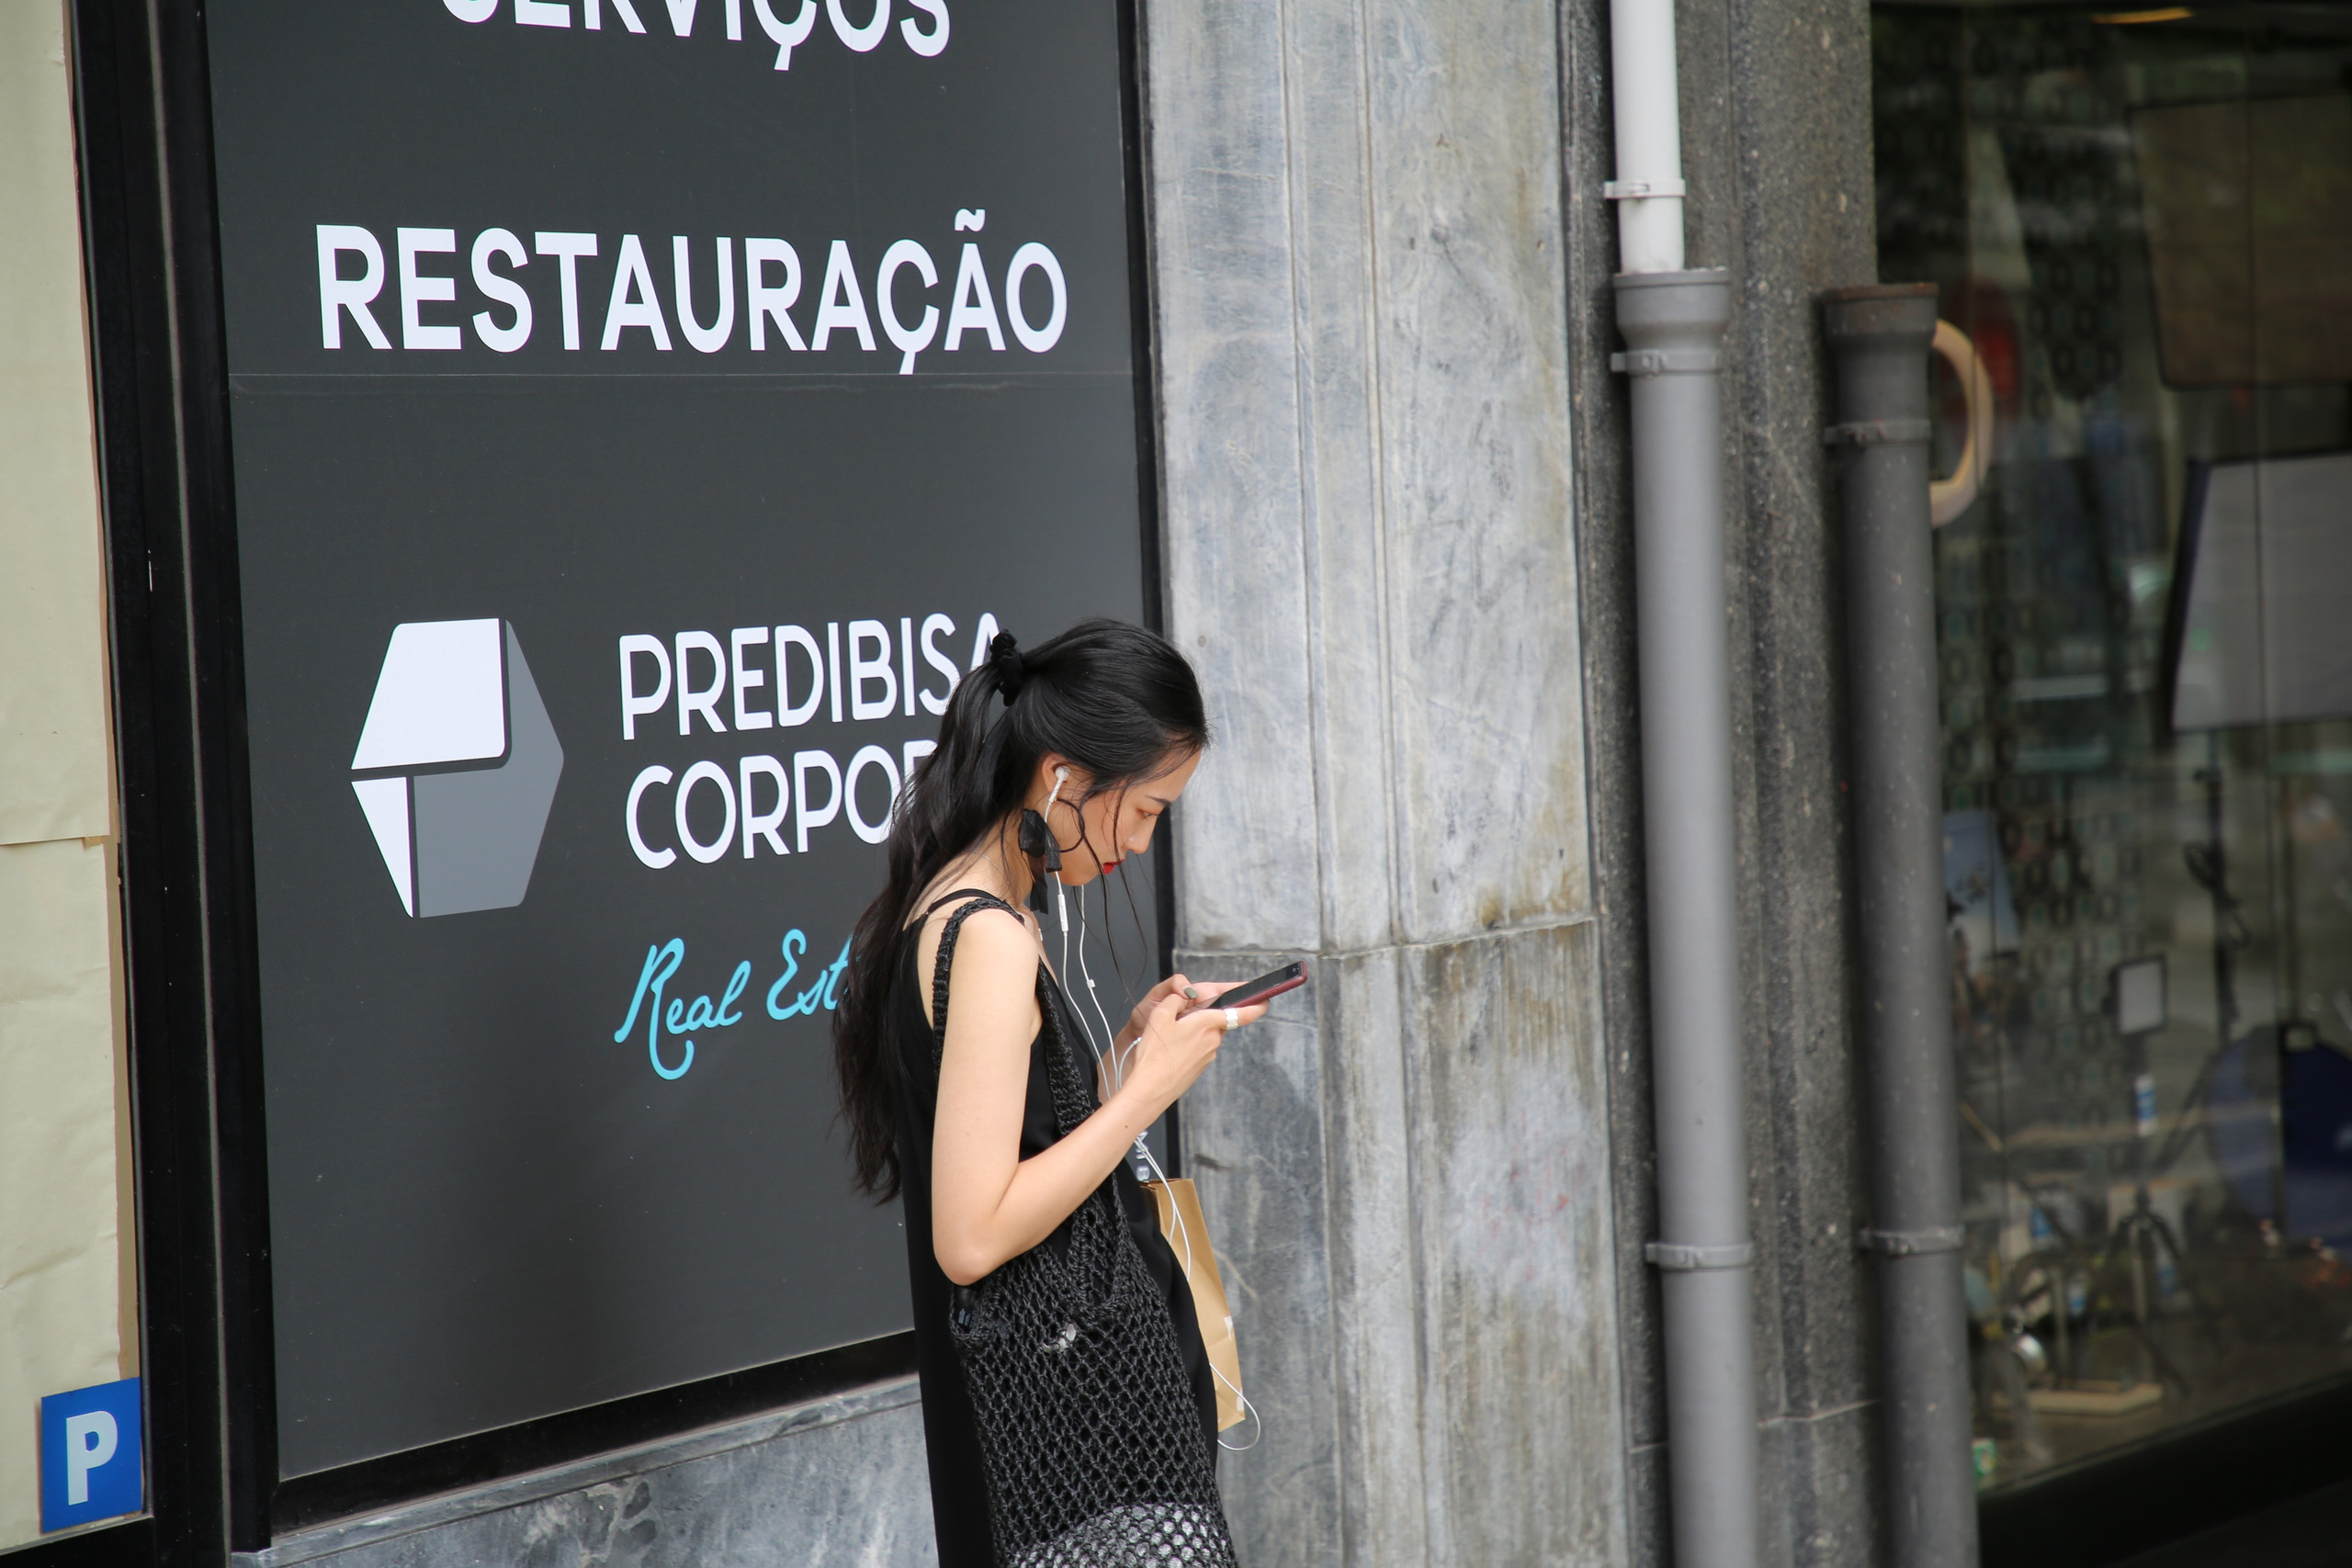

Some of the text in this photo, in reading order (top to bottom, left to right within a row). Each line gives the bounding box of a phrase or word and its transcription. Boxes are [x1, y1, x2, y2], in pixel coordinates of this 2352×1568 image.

[317, 209, 1068, 376] RESTAURAÇÃO
[626, 739, 939, 870] CORPO
[613, 928, 853, 1080] Real Est
[66, 1410, 118, 1505] P
